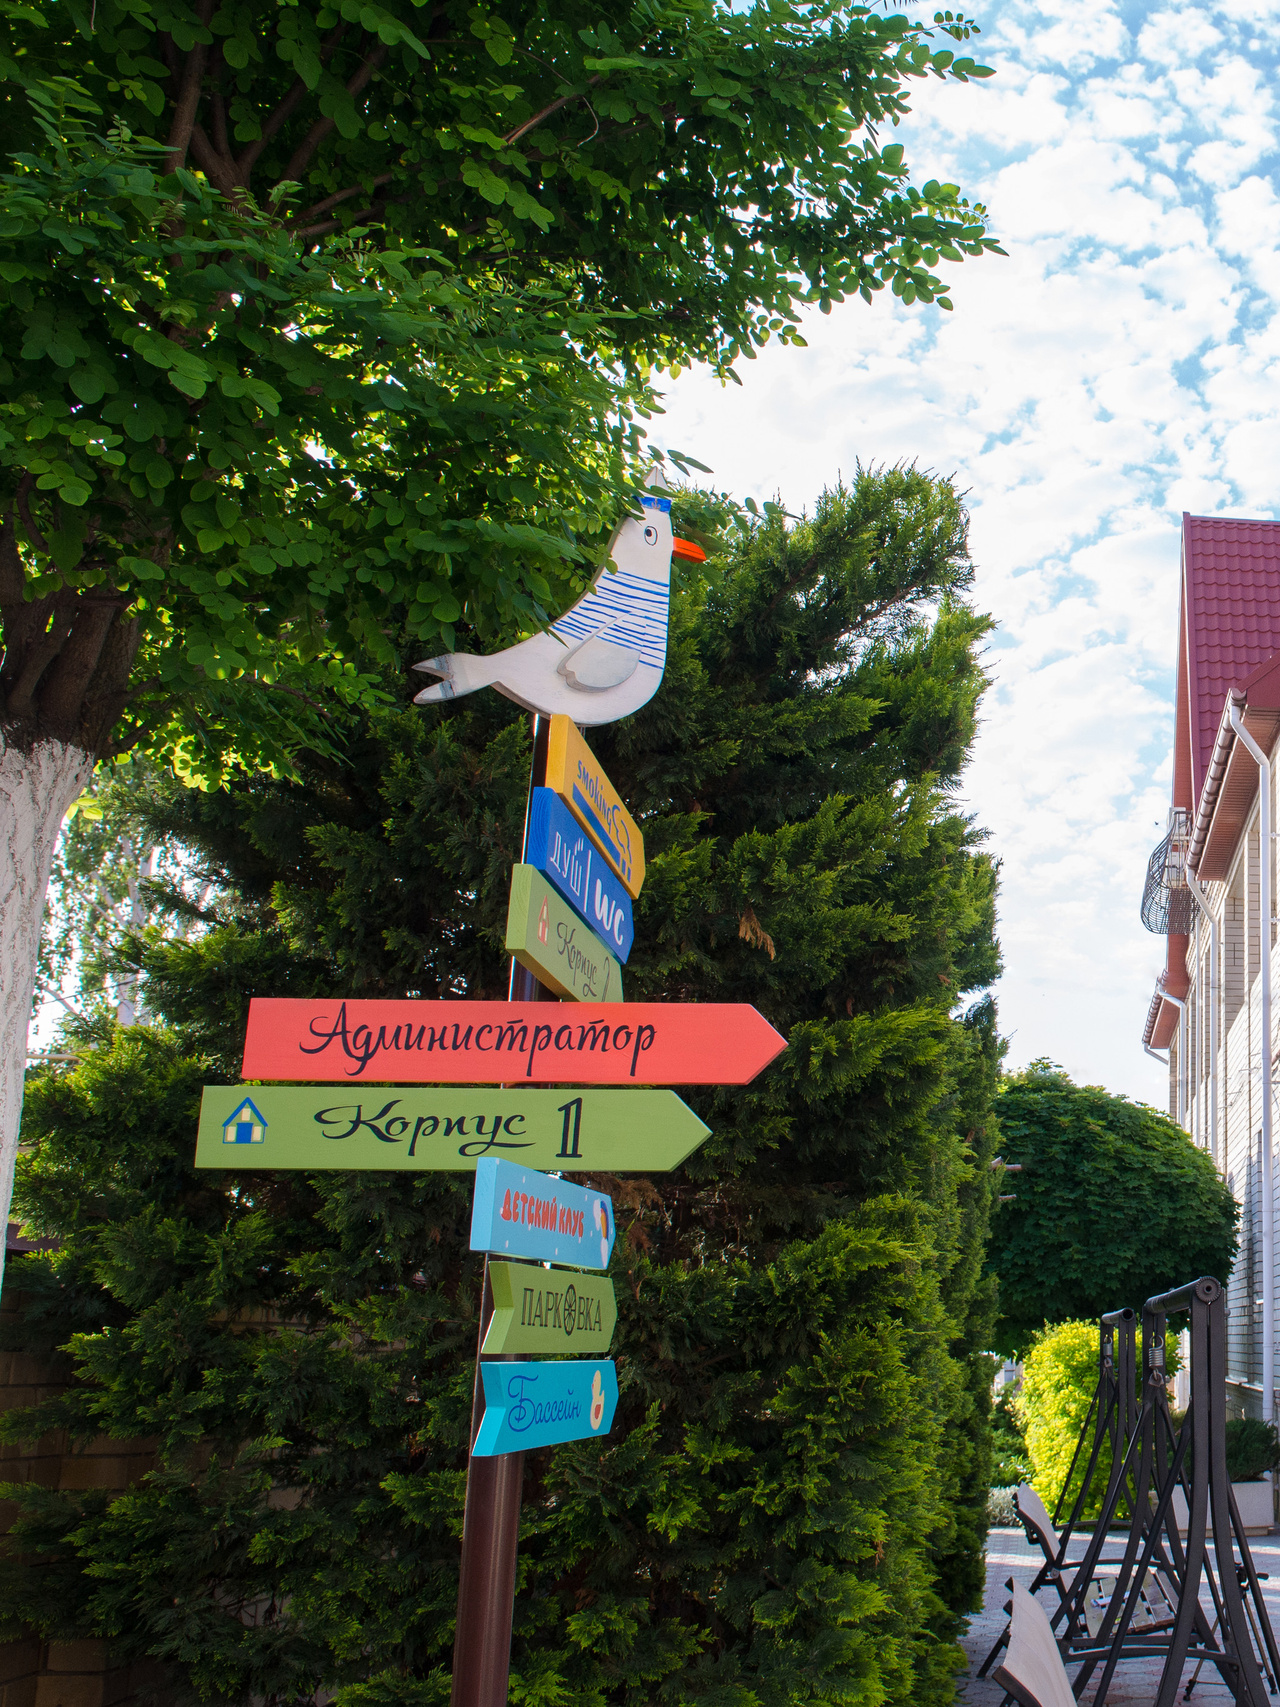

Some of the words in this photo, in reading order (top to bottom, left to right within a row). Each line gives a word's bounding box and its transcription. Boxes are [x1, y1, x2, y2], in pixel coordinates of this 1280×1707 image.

[594, 878, 625, 946] WC
[556, 921, 598, 997] Корпус
[300, 1001, 658, 1077] Администратор
[314, 1099, 537, 1158] Корпус
[556, 1097, 584, 1159] 1
[501, 1188, 558, 1233] ДЕТСКИЙ
[558, 1204, 585, 1238] КЛУБ
[521, 1283, 602, 1336] ПАРКОВКА
[508, 1374, 582, 1433] Бассейн
